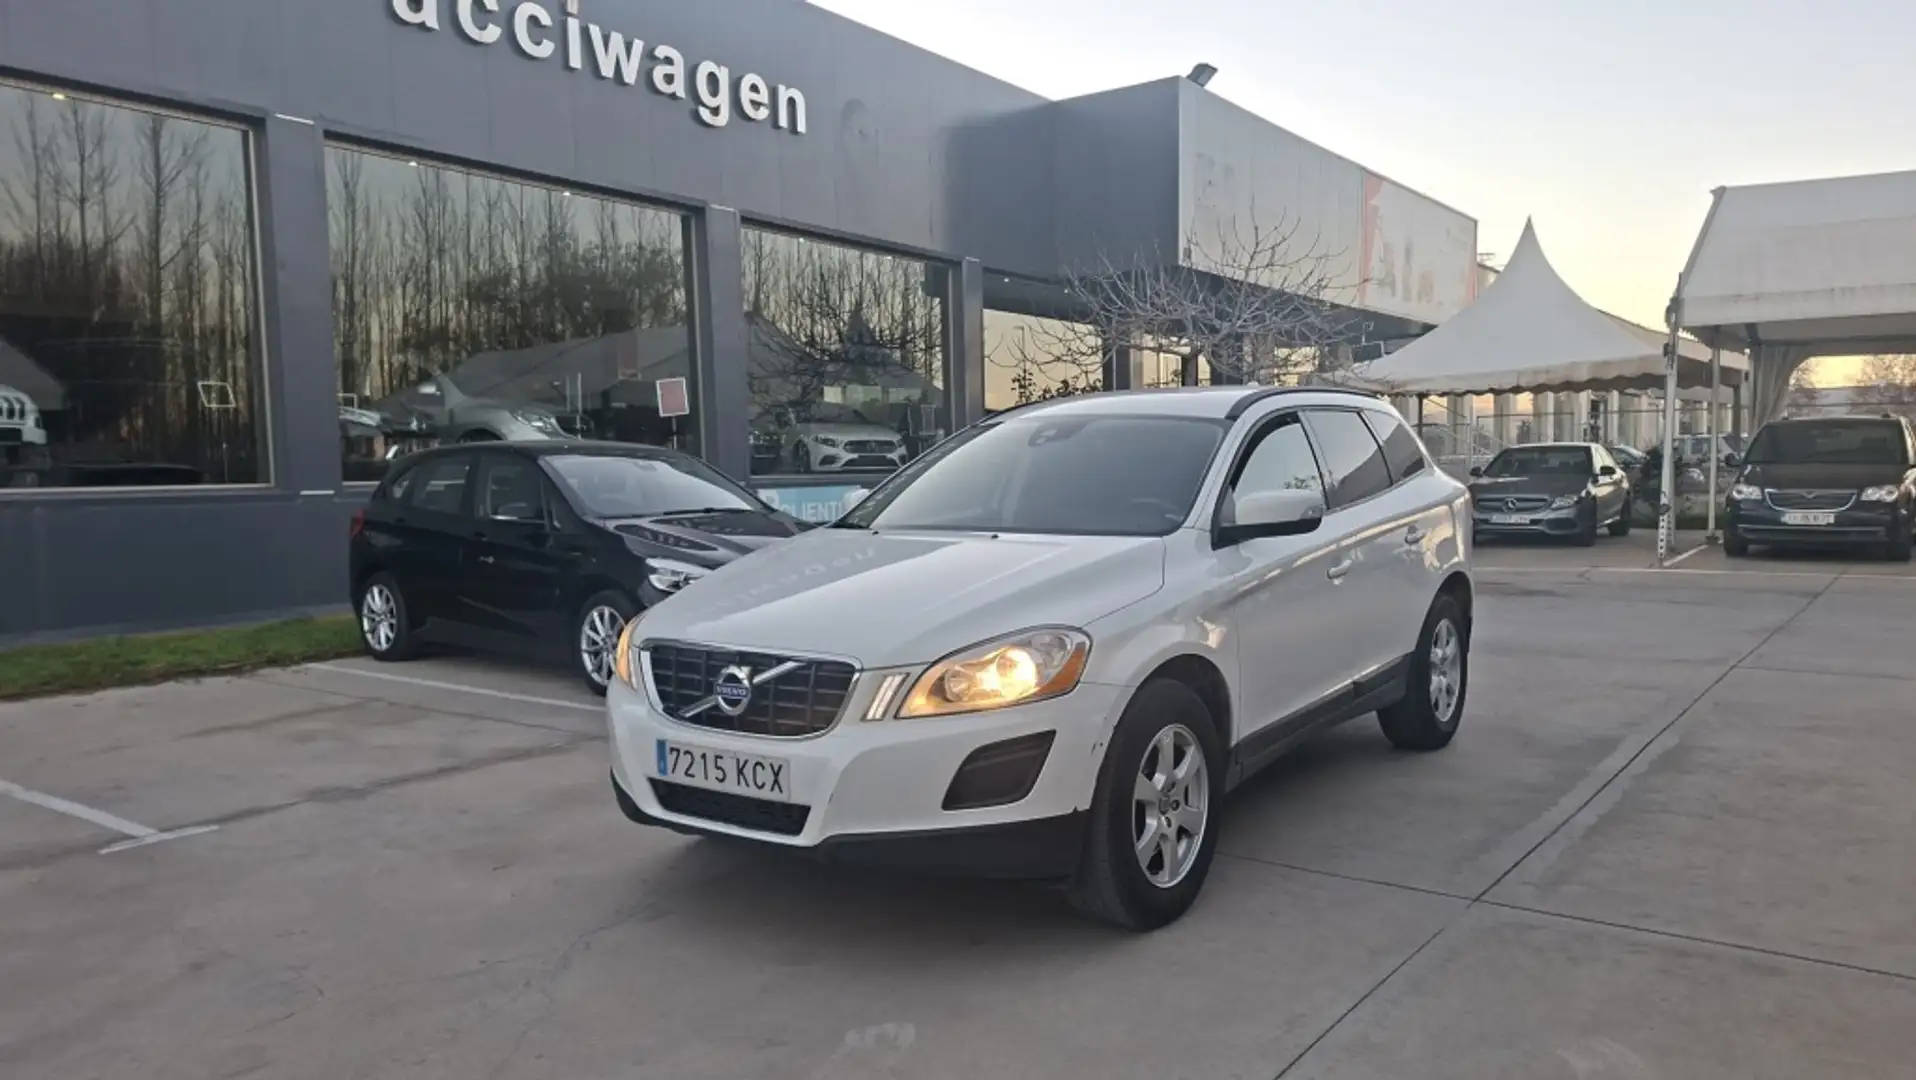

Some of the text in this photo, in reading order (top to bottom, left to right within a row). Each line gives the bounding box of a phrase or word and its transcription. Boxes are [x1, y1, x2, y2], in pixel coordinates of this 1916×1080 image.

[716, 685, 747, 696] VOLVO
[669, 746, 784, 795] 7215 KCX
